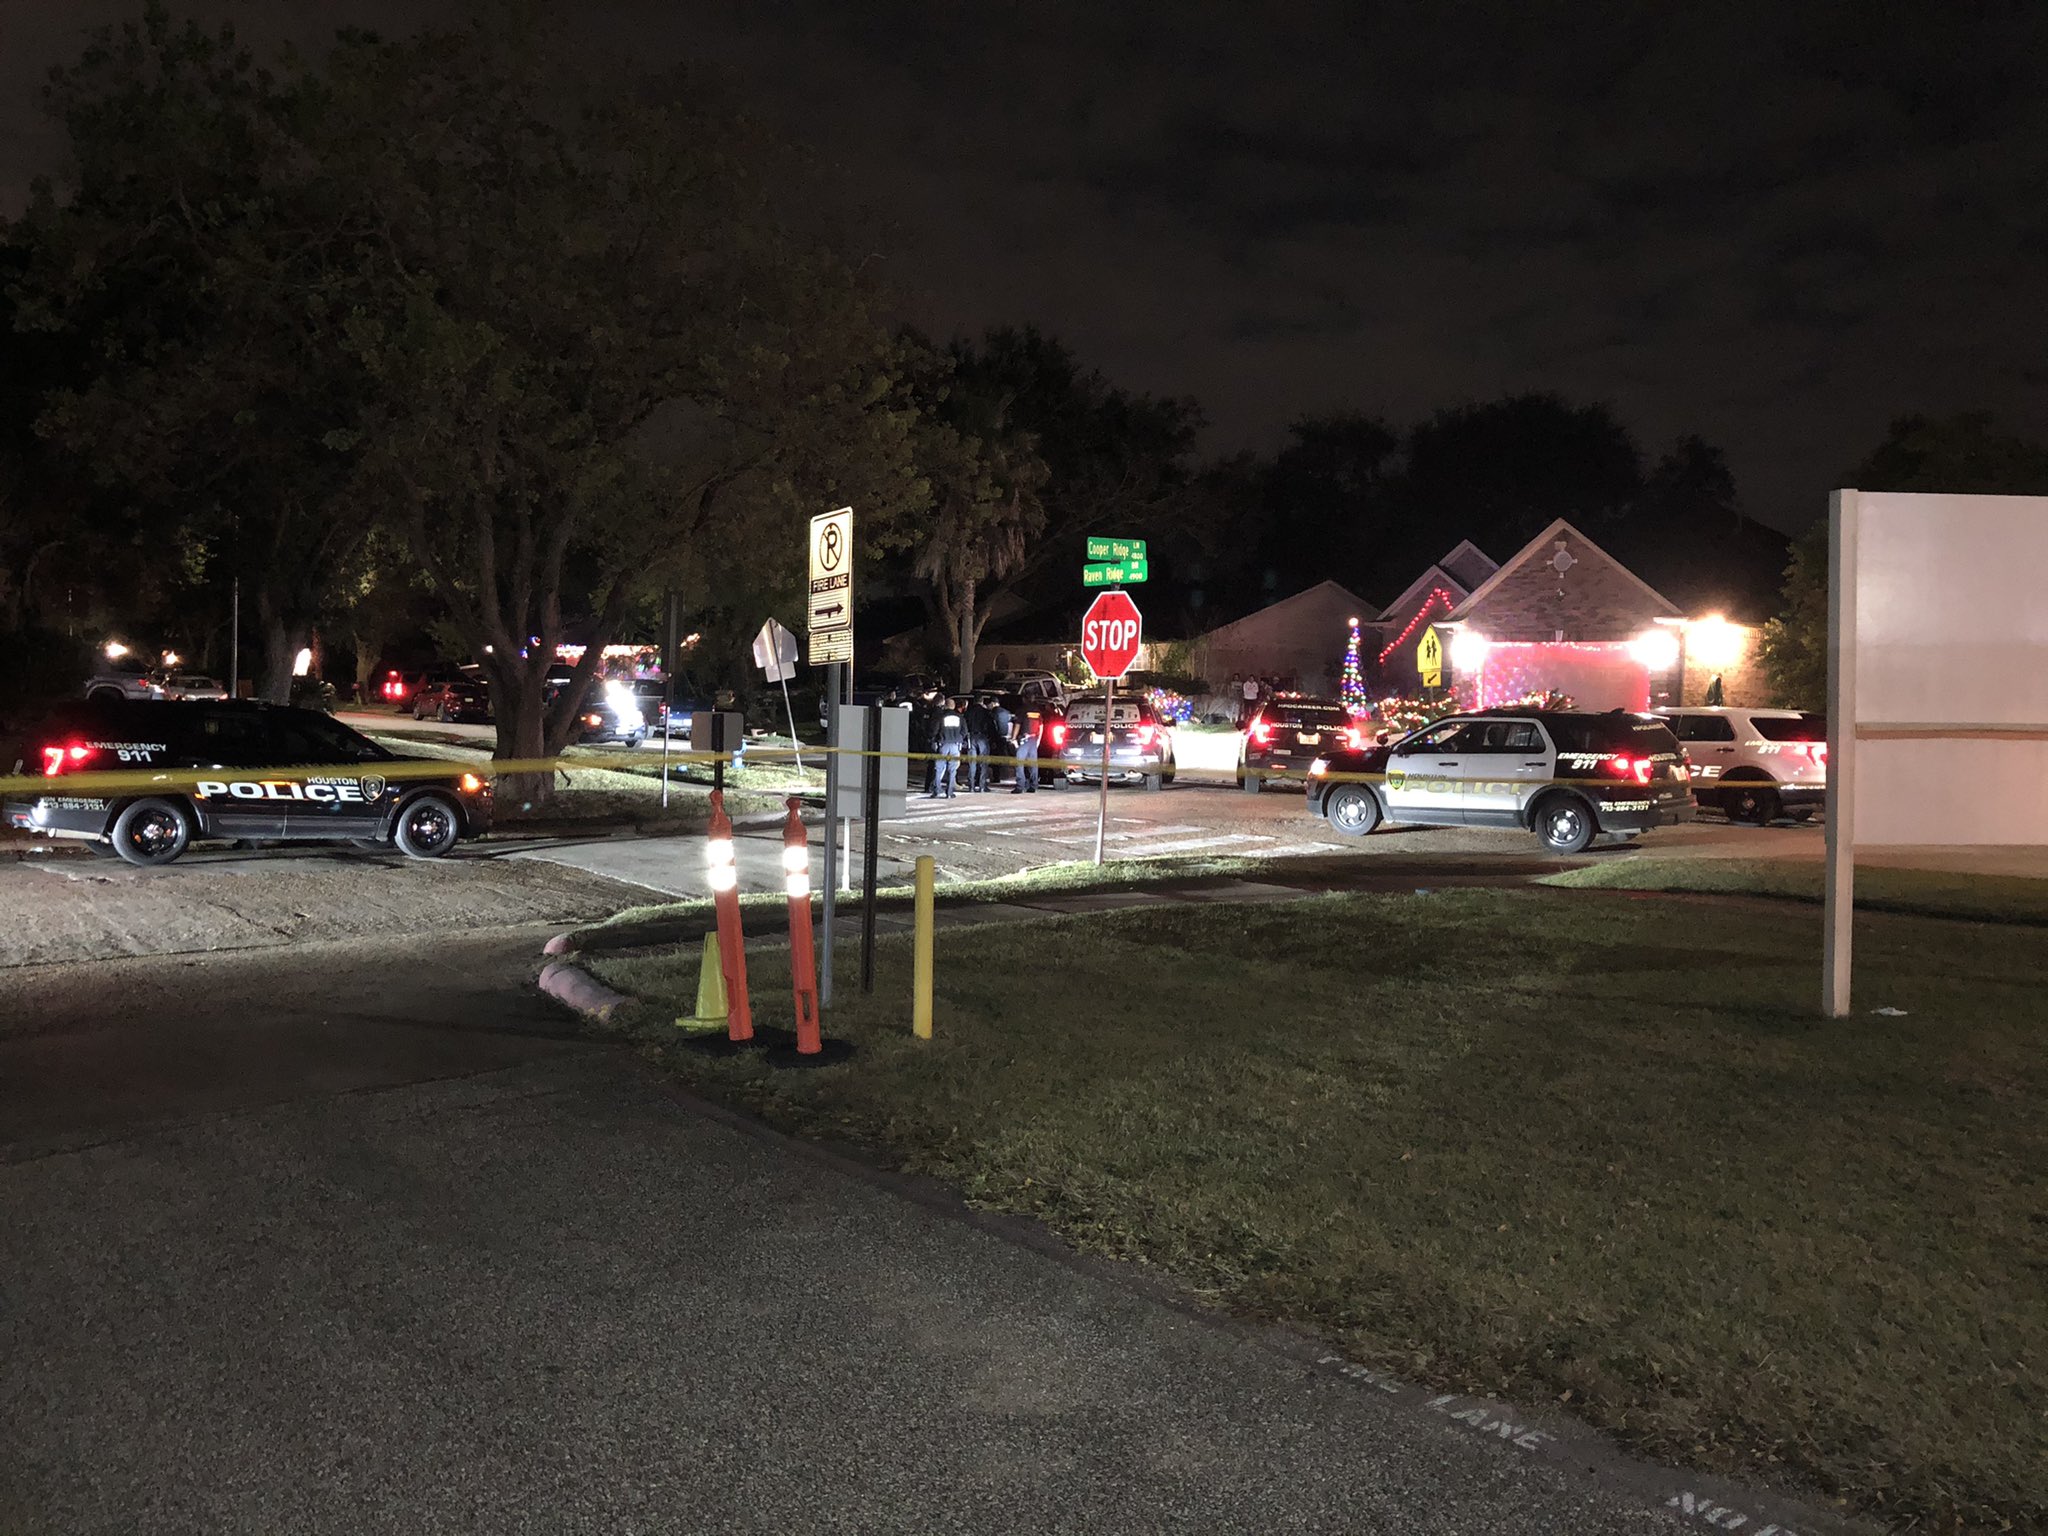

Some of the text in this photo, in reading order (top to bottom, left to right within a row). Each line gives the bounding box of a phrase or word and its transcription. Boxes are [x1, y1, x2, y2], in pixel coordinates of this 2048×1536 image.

[1088, 541, 1129, 560] Cooper Ridge
[1133, 541, 1140, 549] LN
[1084, 567, 1124, 582] Raven Ridge
[812, 573, 848, 593] FIRE LANE
[1085, 619, 1137, 651] STOP
[85, 741, 167, 752] EMERGENCY
[118, 750, 152, 762] 911
[1557, 752, 1619, 760] EMERGENCY
[1571, 759, 1598, 769] 911
[307, 776, 358, 785] HOUSTON
[197, 781, 364, 802] POLICE
[1419, 1395, 1558, 1451] LANE
